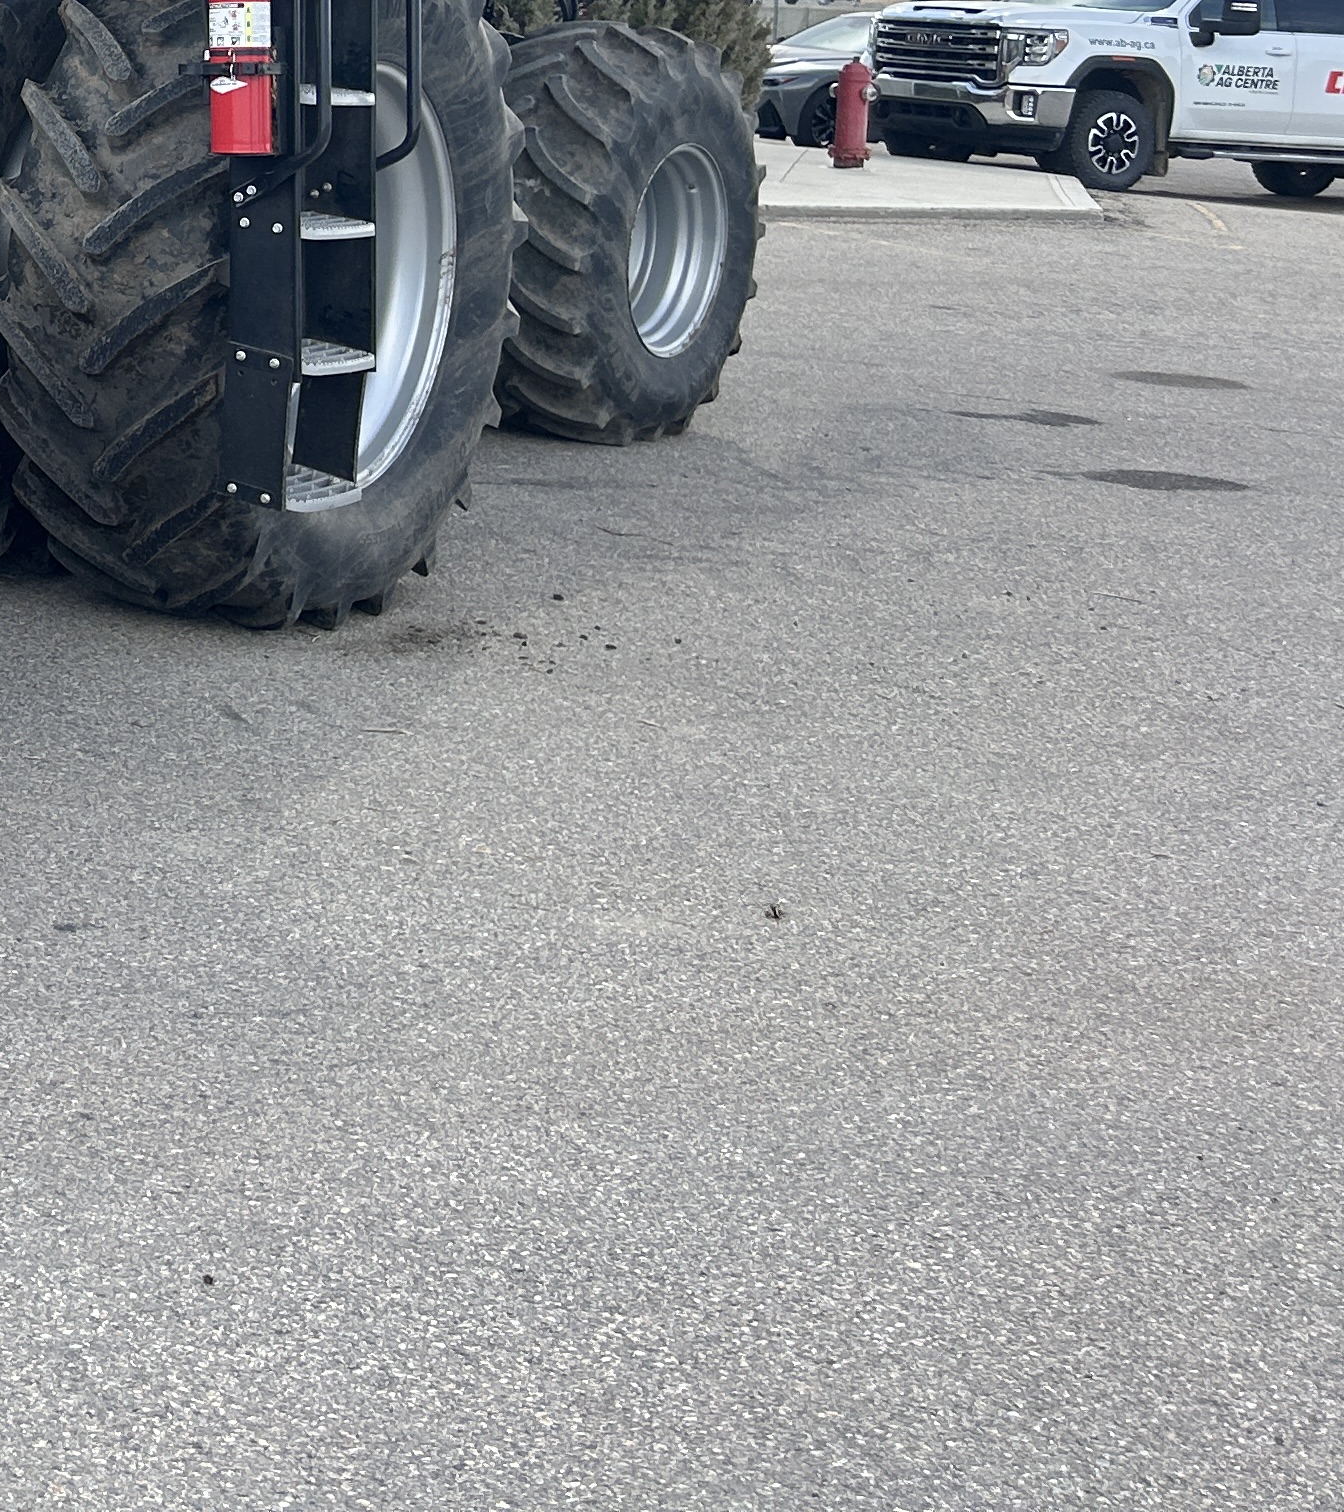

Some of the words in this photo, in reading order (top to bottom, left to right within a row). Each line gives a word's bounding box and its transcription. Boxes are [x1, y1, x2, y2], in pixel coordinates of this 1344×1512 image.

[1088, 38, 1156, 51] www.ab-ag.ca
[1221, 64, 1274, 78] ALBERTA
[1215, 77, 1233, 88] AG
[1235, 78, 1280, 90] CENTRE
